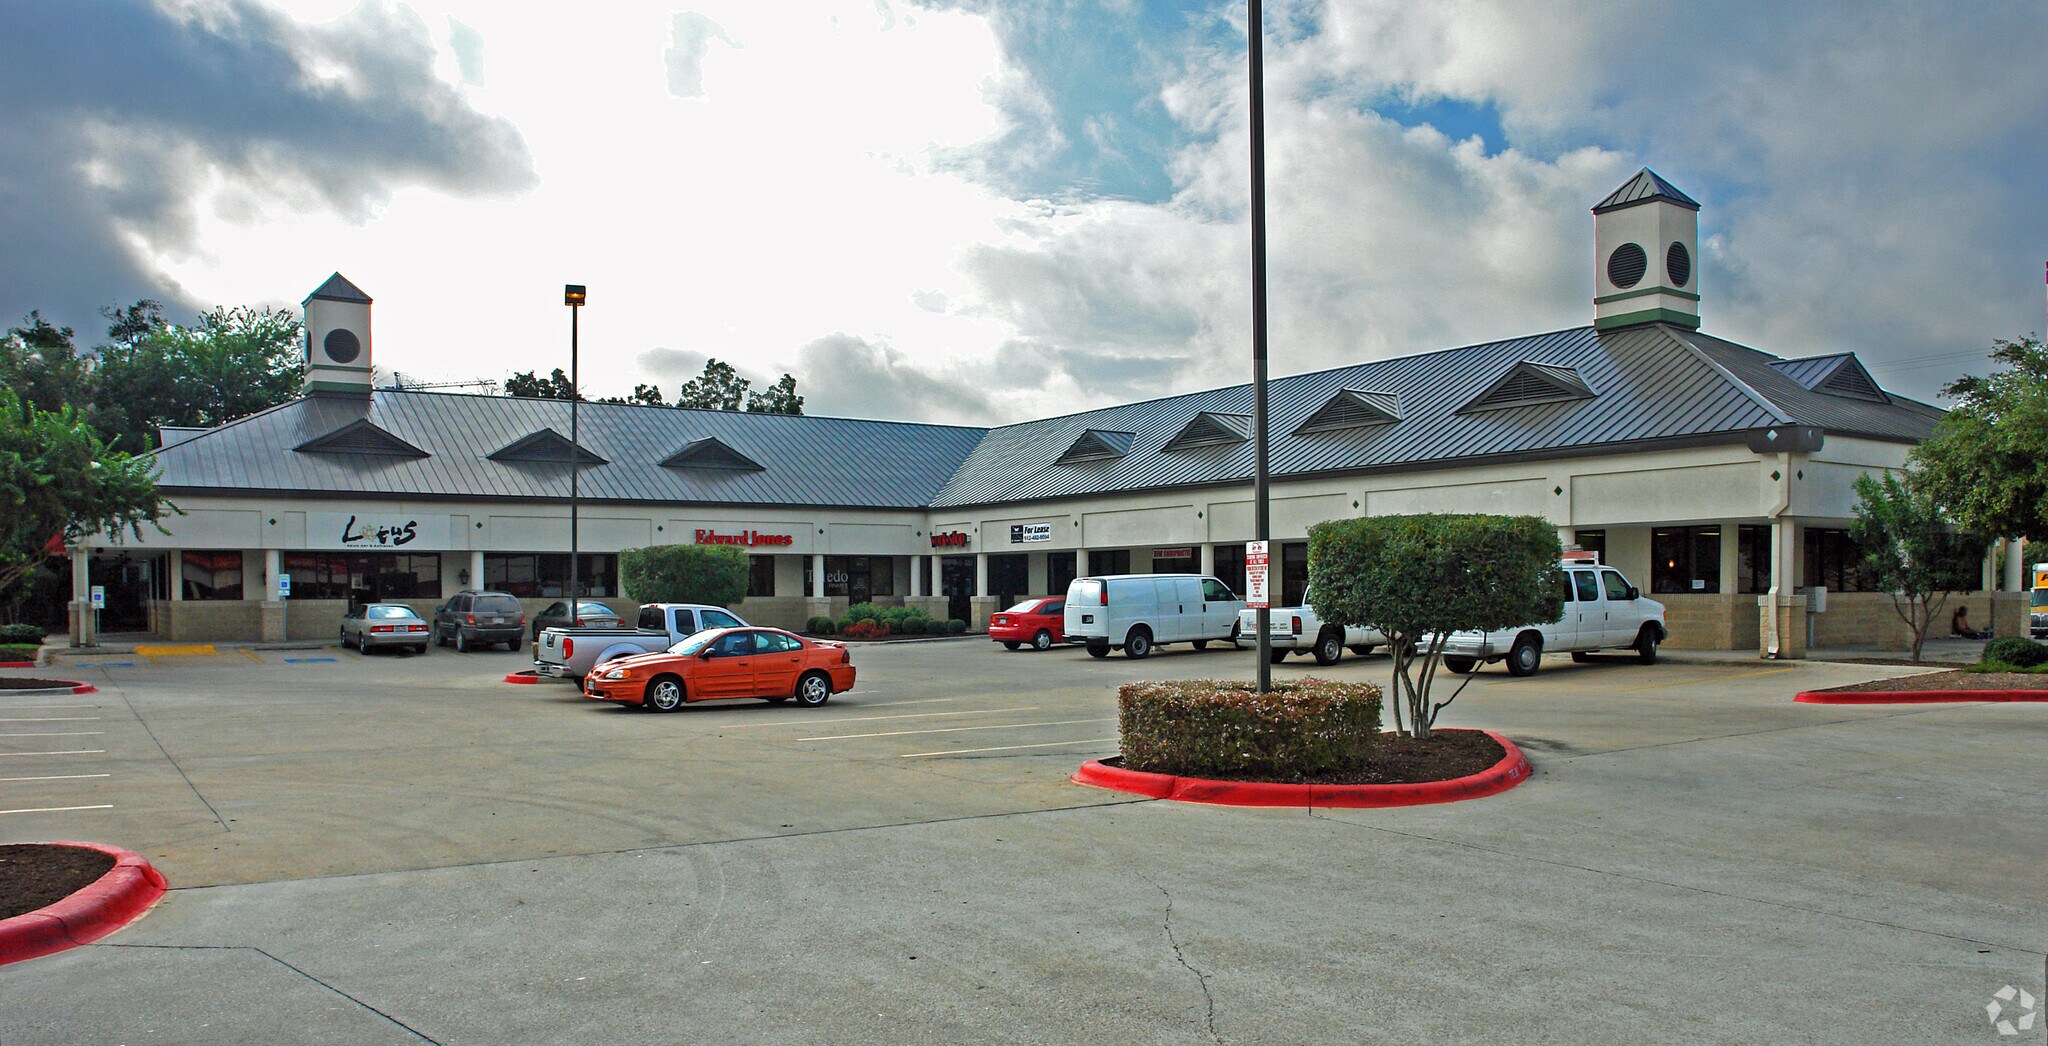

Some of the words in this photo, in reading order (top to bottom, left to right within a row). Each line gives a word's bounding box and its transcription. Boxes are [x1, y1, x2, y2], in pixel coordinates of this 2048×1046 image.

[1024, 526, 1034, 534] For
[1034, 525, 1050, 534] Lease
[695, 530, 749, 545] Edward
[749, 530, 793, 547] Jones
[805, 570, 849, 583] Tedo
